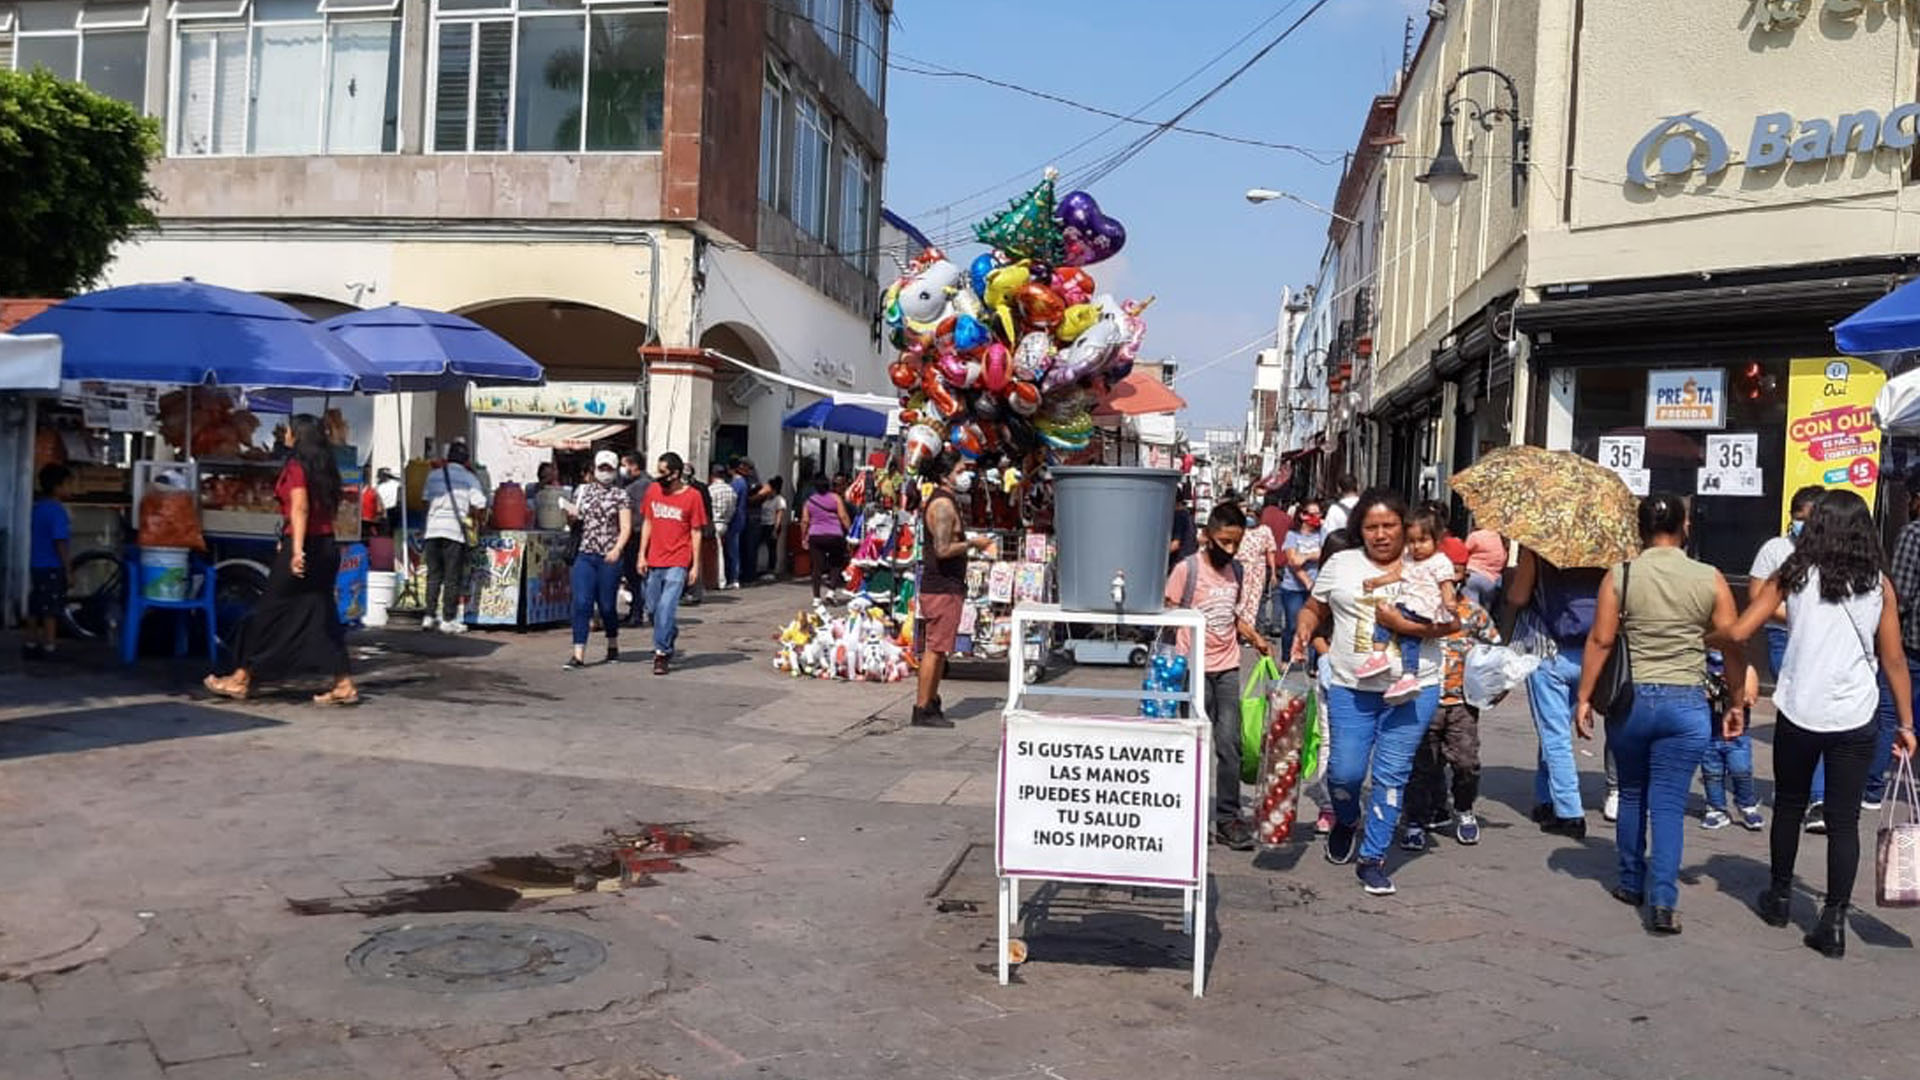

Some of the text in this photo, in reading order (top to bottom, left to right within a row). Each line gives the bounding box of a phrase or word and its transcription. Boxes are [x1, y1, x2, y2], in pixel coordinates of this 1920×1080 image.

[1791, 418, 1833, 439] CON
[1610, 444, 1633, 468] 35
[1719, 443, 1743, 468] 35
[1018, 741, 1185, 764] SI GUSTAS LAVARTE
[1050, 764, 1151, 785] LAS MANOS
[1018, 784, 1091, 804] !PUEDES
[1057, 808, 1142, 829] TU SALUD
[1033, 829, 1076, 847] !NOS
